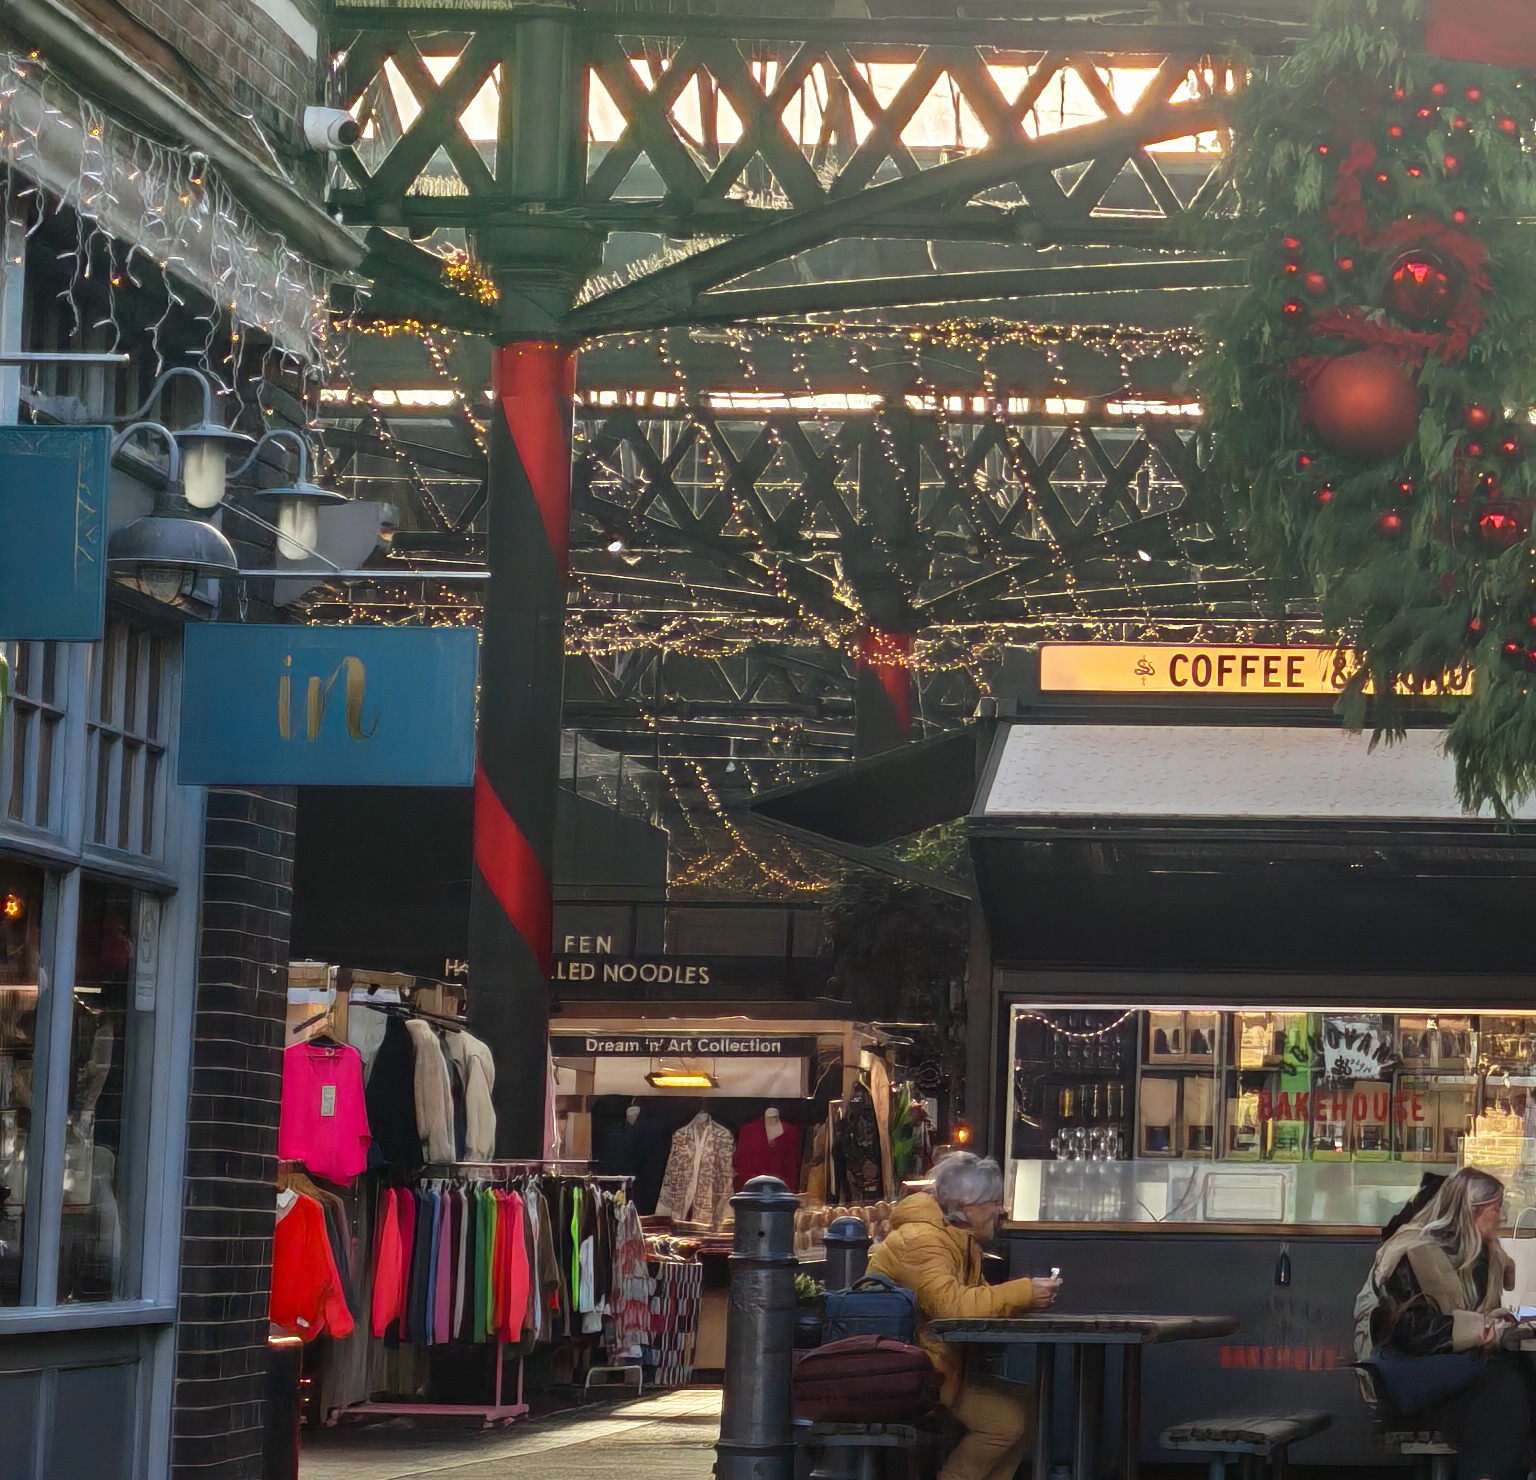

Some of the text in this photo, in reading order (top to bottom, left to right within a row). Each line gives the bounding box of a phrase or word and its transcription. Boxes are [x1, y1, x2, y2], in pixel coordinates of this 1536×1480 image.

[1168, 653, 1306, 688] COFFEE
[276, 653, 381, 741] in
[564, 935, 612, 954] FEN
[603, 963, 710, 985] NOODLES
[585, 1038, 639, 1053] Dream
[668, 1038, 693, 1053] Art
[697, 1038, 782, 1054] Collection
[1258, 1090, 1426, 1123] BAKEHOUSE
